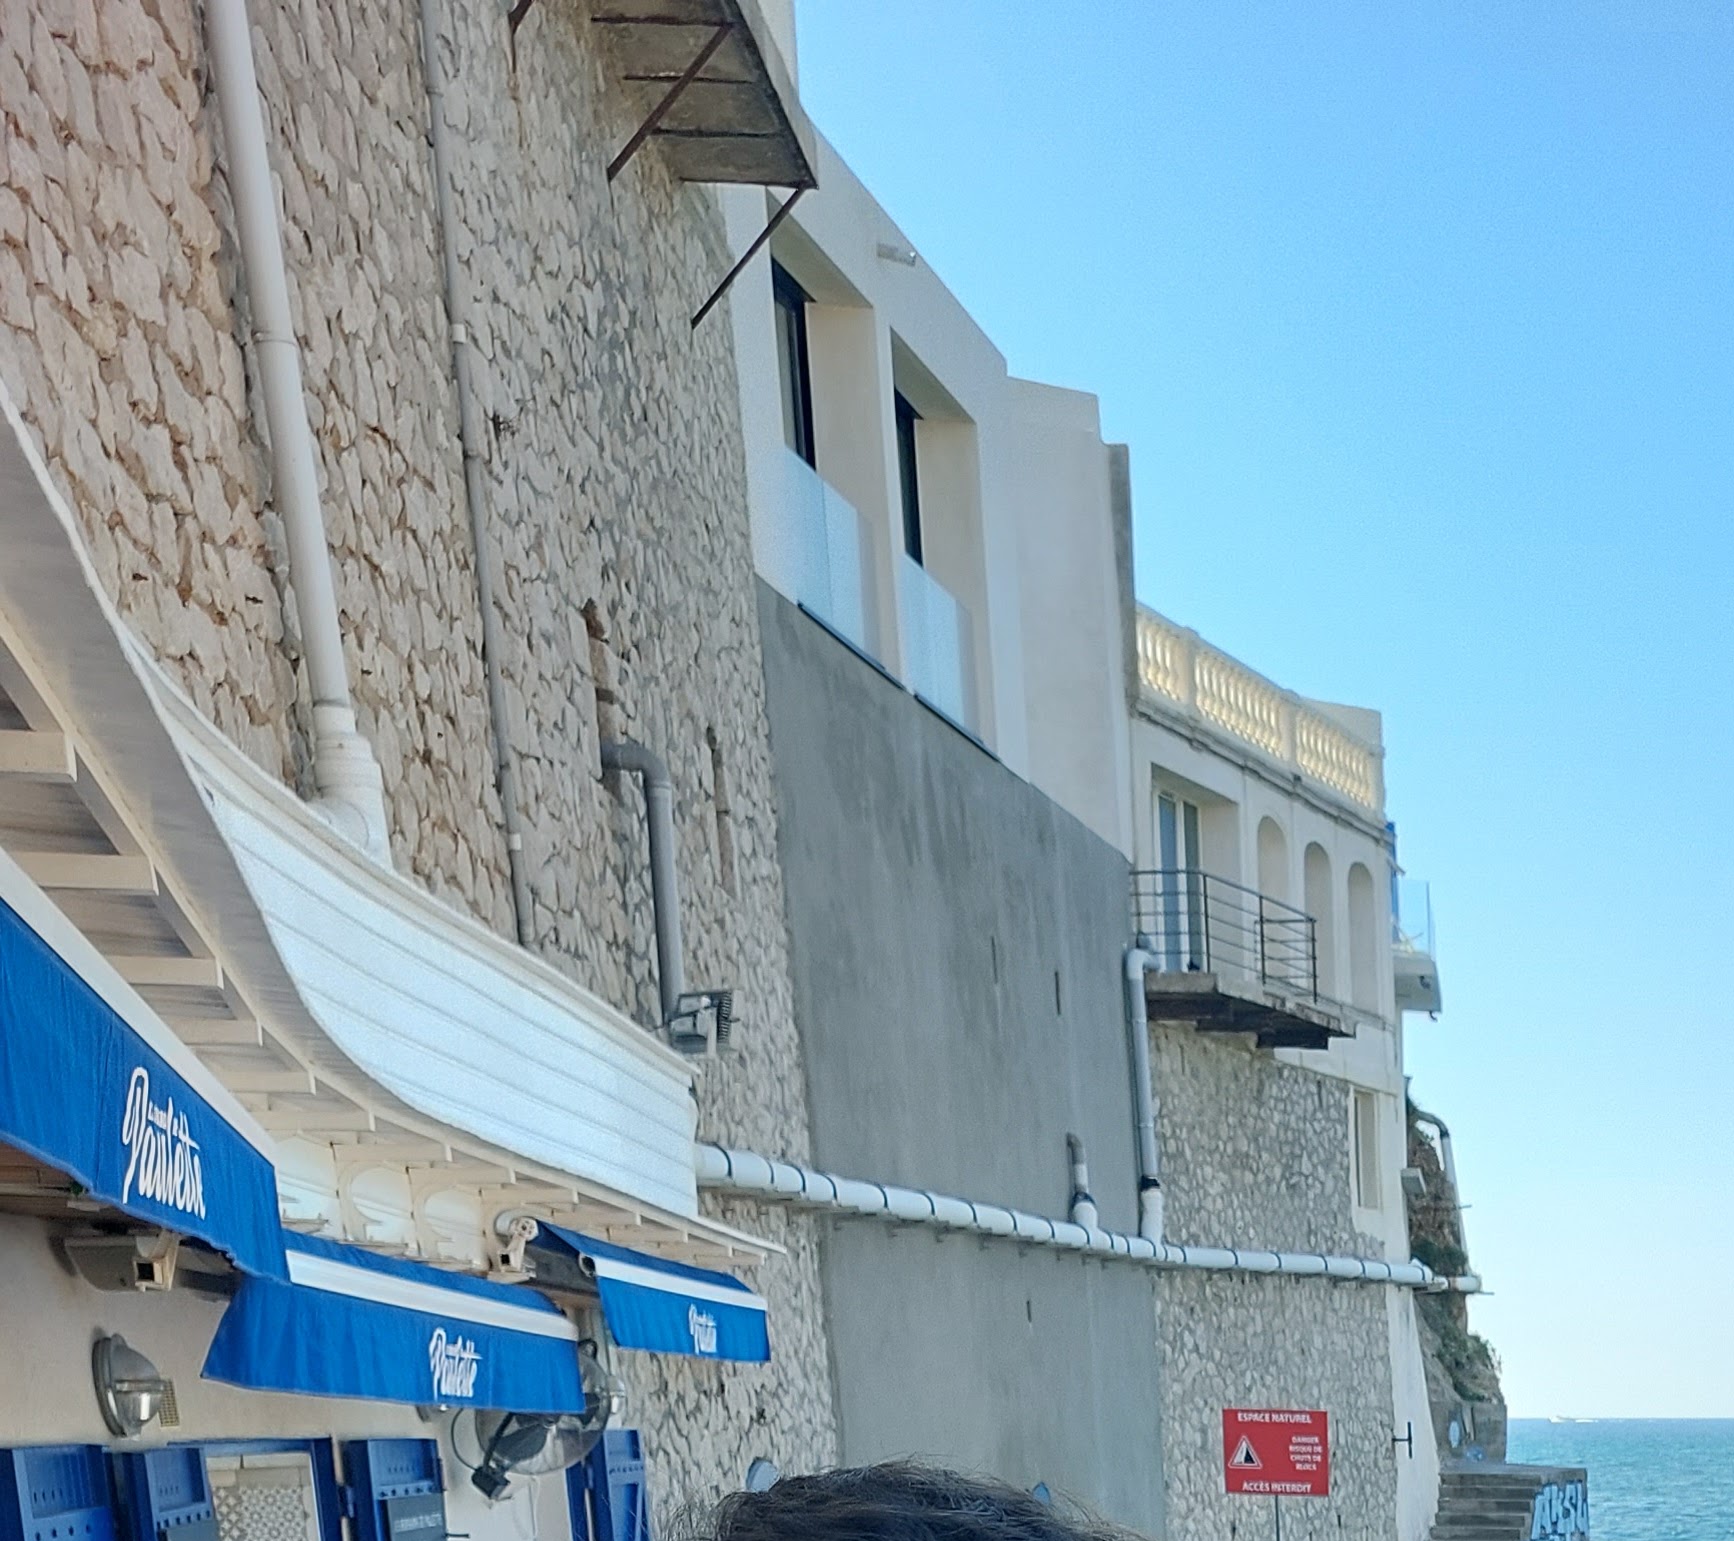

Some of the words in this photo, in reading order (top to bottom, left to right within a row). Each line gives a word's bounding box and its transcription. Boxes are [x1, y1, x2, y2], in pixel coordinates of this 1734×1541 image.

[1237, 1412, 1270, 1422] ESPACE
[1271, 1413, 1312, 1424] NATUREL
[1242, 1481, 1270, 1492] ACCÈS
[1271, 1482, 1312, 1493] INTERDIT
